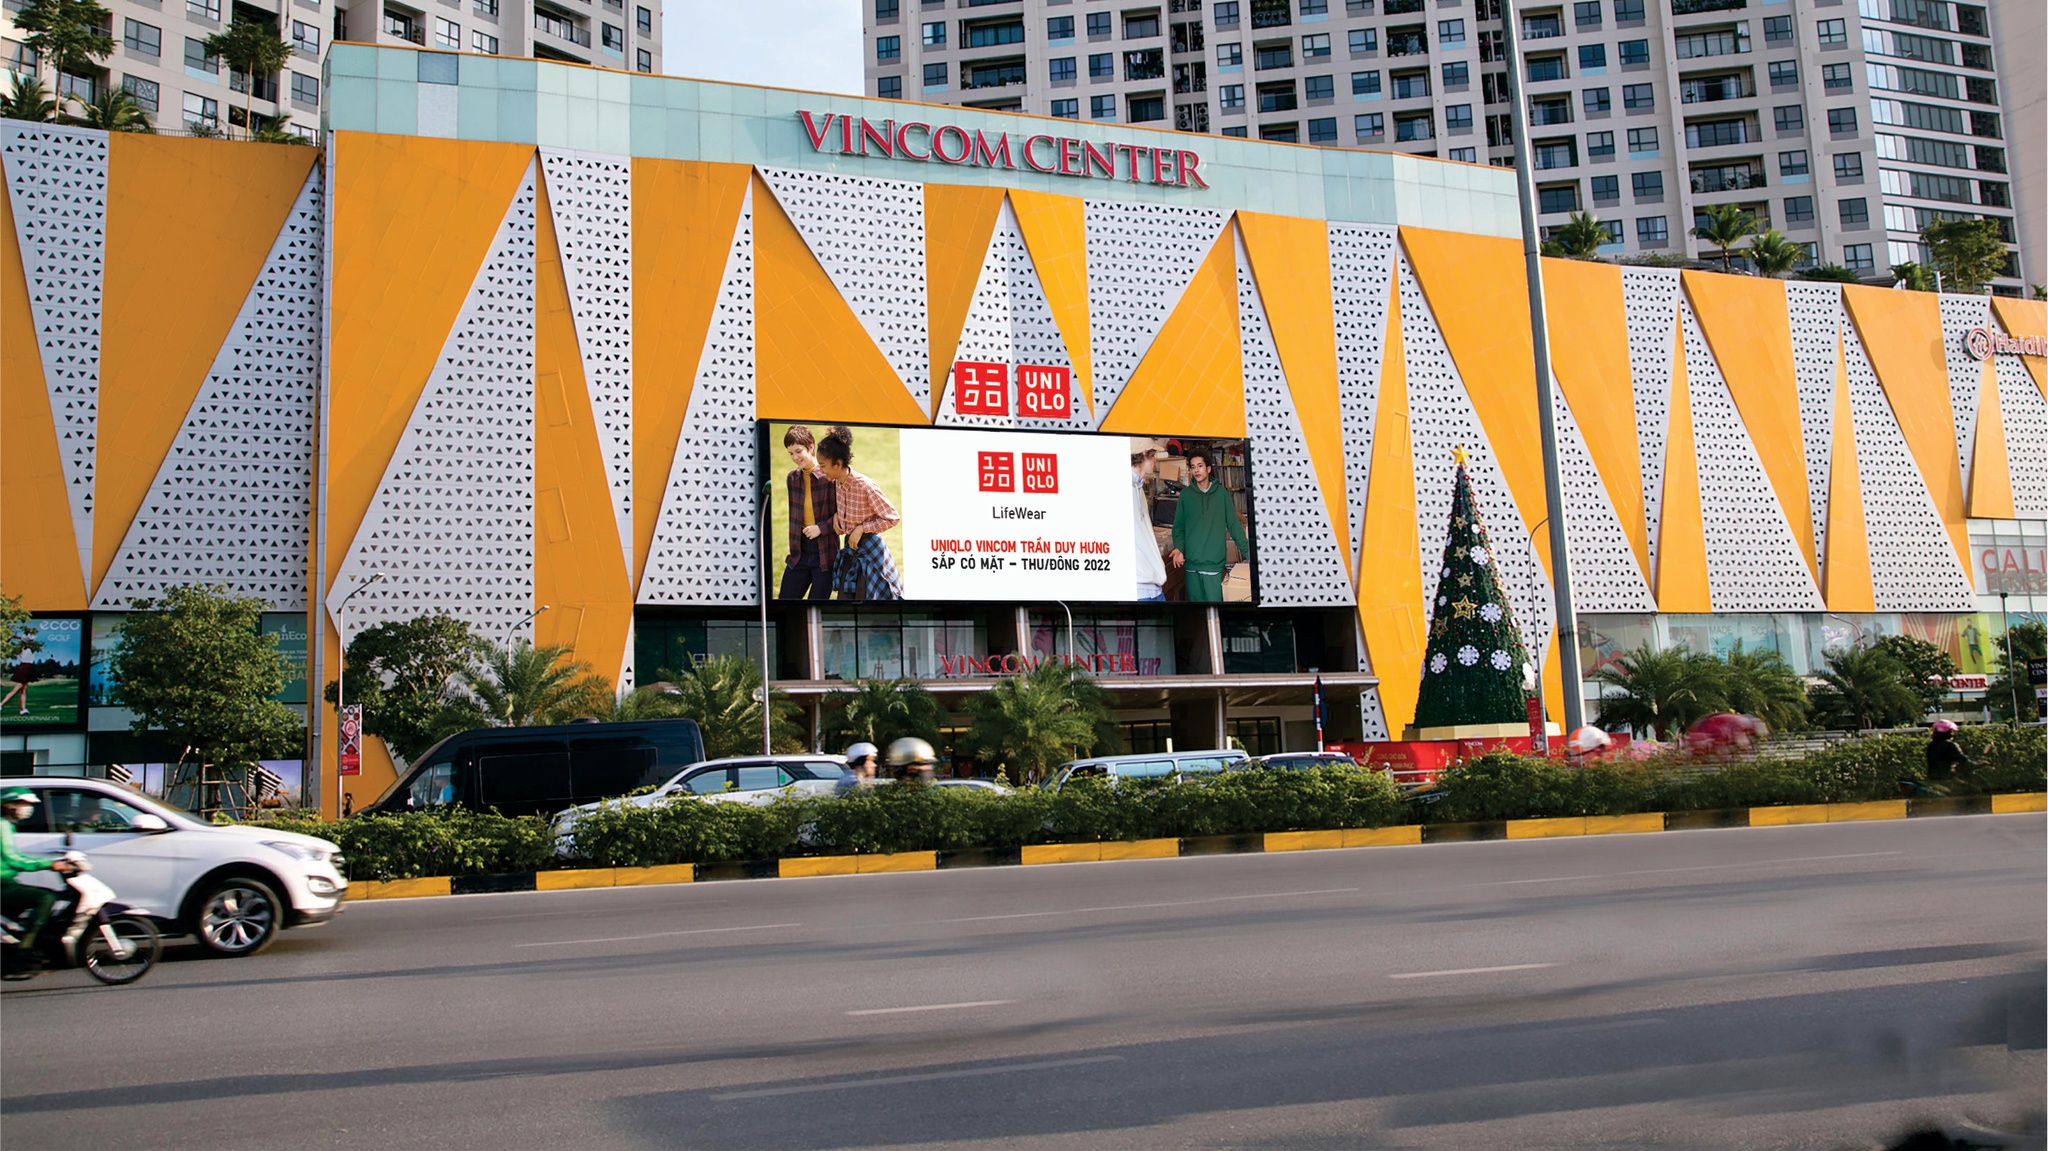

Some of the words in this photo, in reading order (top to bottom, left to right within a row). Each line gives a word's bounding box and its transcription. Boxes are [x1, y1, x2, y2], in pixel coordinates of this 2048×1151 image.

[796, 109, 1016, 170] VINCOM
[1022, 134, 1210, 190] CENTER
[1995, 333, 2047, 358] Haidil
[992, 506, 1047, 520] LifeWear
[931, 539, 972, 554] UNIQLO
[976, 540, 1017, 552] VINCOM
[1054, 541, 1076, 553] DUY
[1080, 541, 1110, 554] HƯNG
[932, 552, 956, 570] SẮP
[960, 554, 976, 570] CÓ
[980, 555, 1005, 573] MẶT
[1021, 555, 1080, 571] THU/ĐÔNG
[1084, 558, 1110, 571] 2022
[1981, 548, 2046, 574] CALI
[39, 620, 79, 631] ecco
[47, 633, 71, 642] GOLF
[1050, 653, 1138, 674] NTER
[1951, 677, 1989, 689] CENTER
